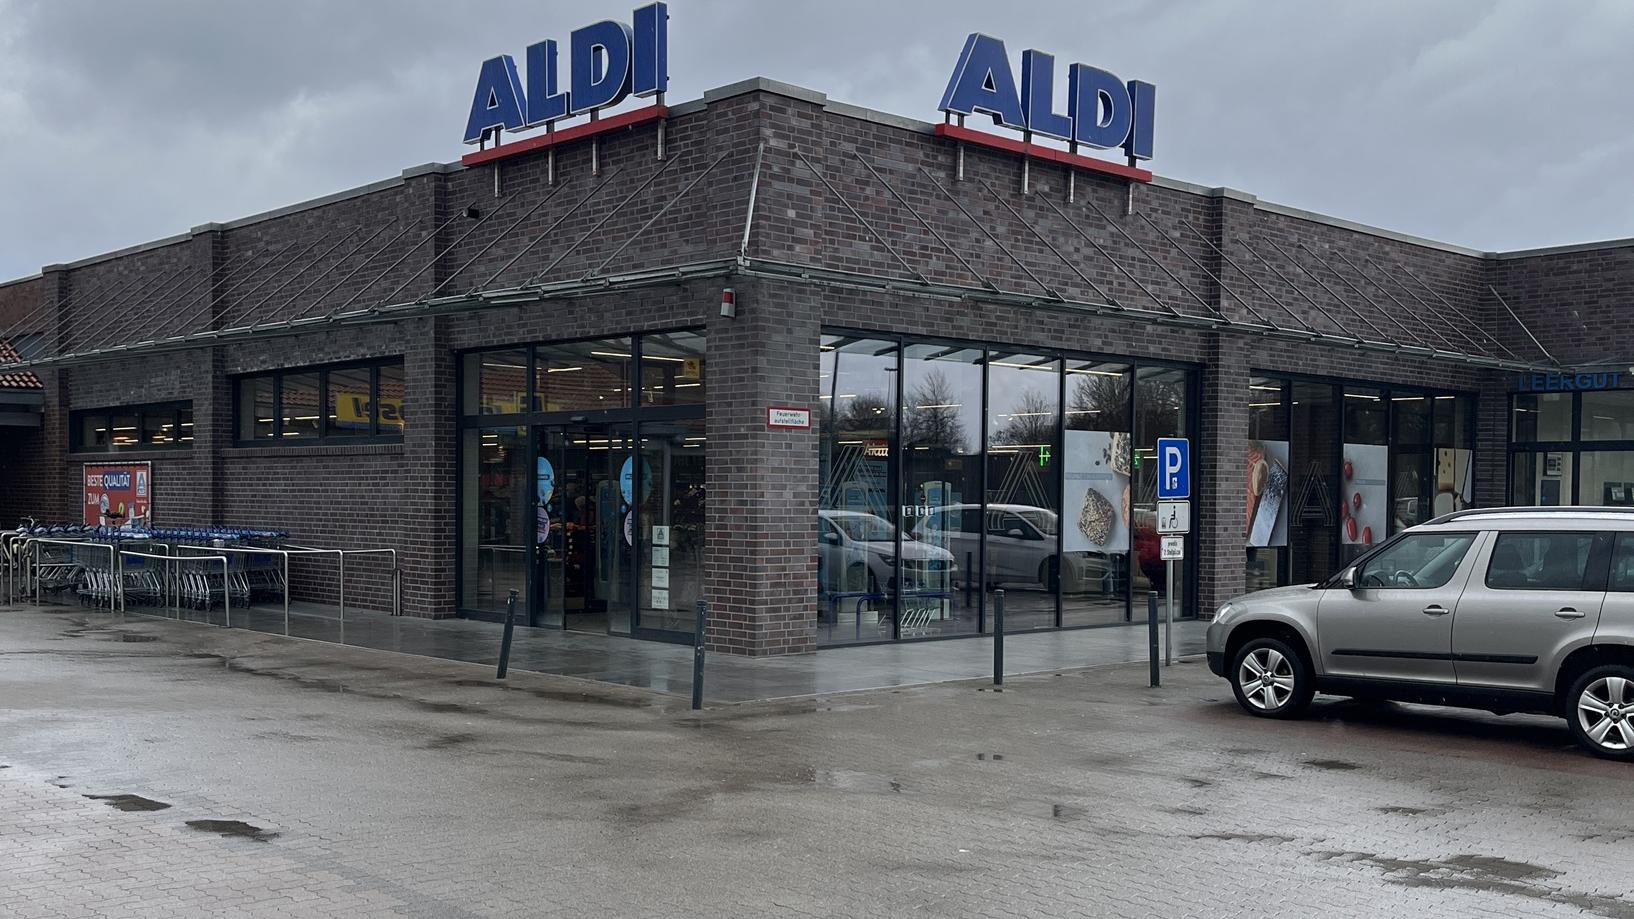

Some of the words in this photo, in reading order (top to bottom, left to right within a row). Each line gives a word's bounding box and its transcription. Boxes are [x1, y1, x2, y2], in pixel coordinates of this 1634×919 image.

[463, 1, 668, 145] ALDI
[937, 32, 1156, 161] ALDI
[1519, 371, 1622, 392] LEERGUT
[87, 474, 103, 487] BESTE
[104, 471, 131, 489] QUALITÄT
[1165, 446, 1182, 490] P
